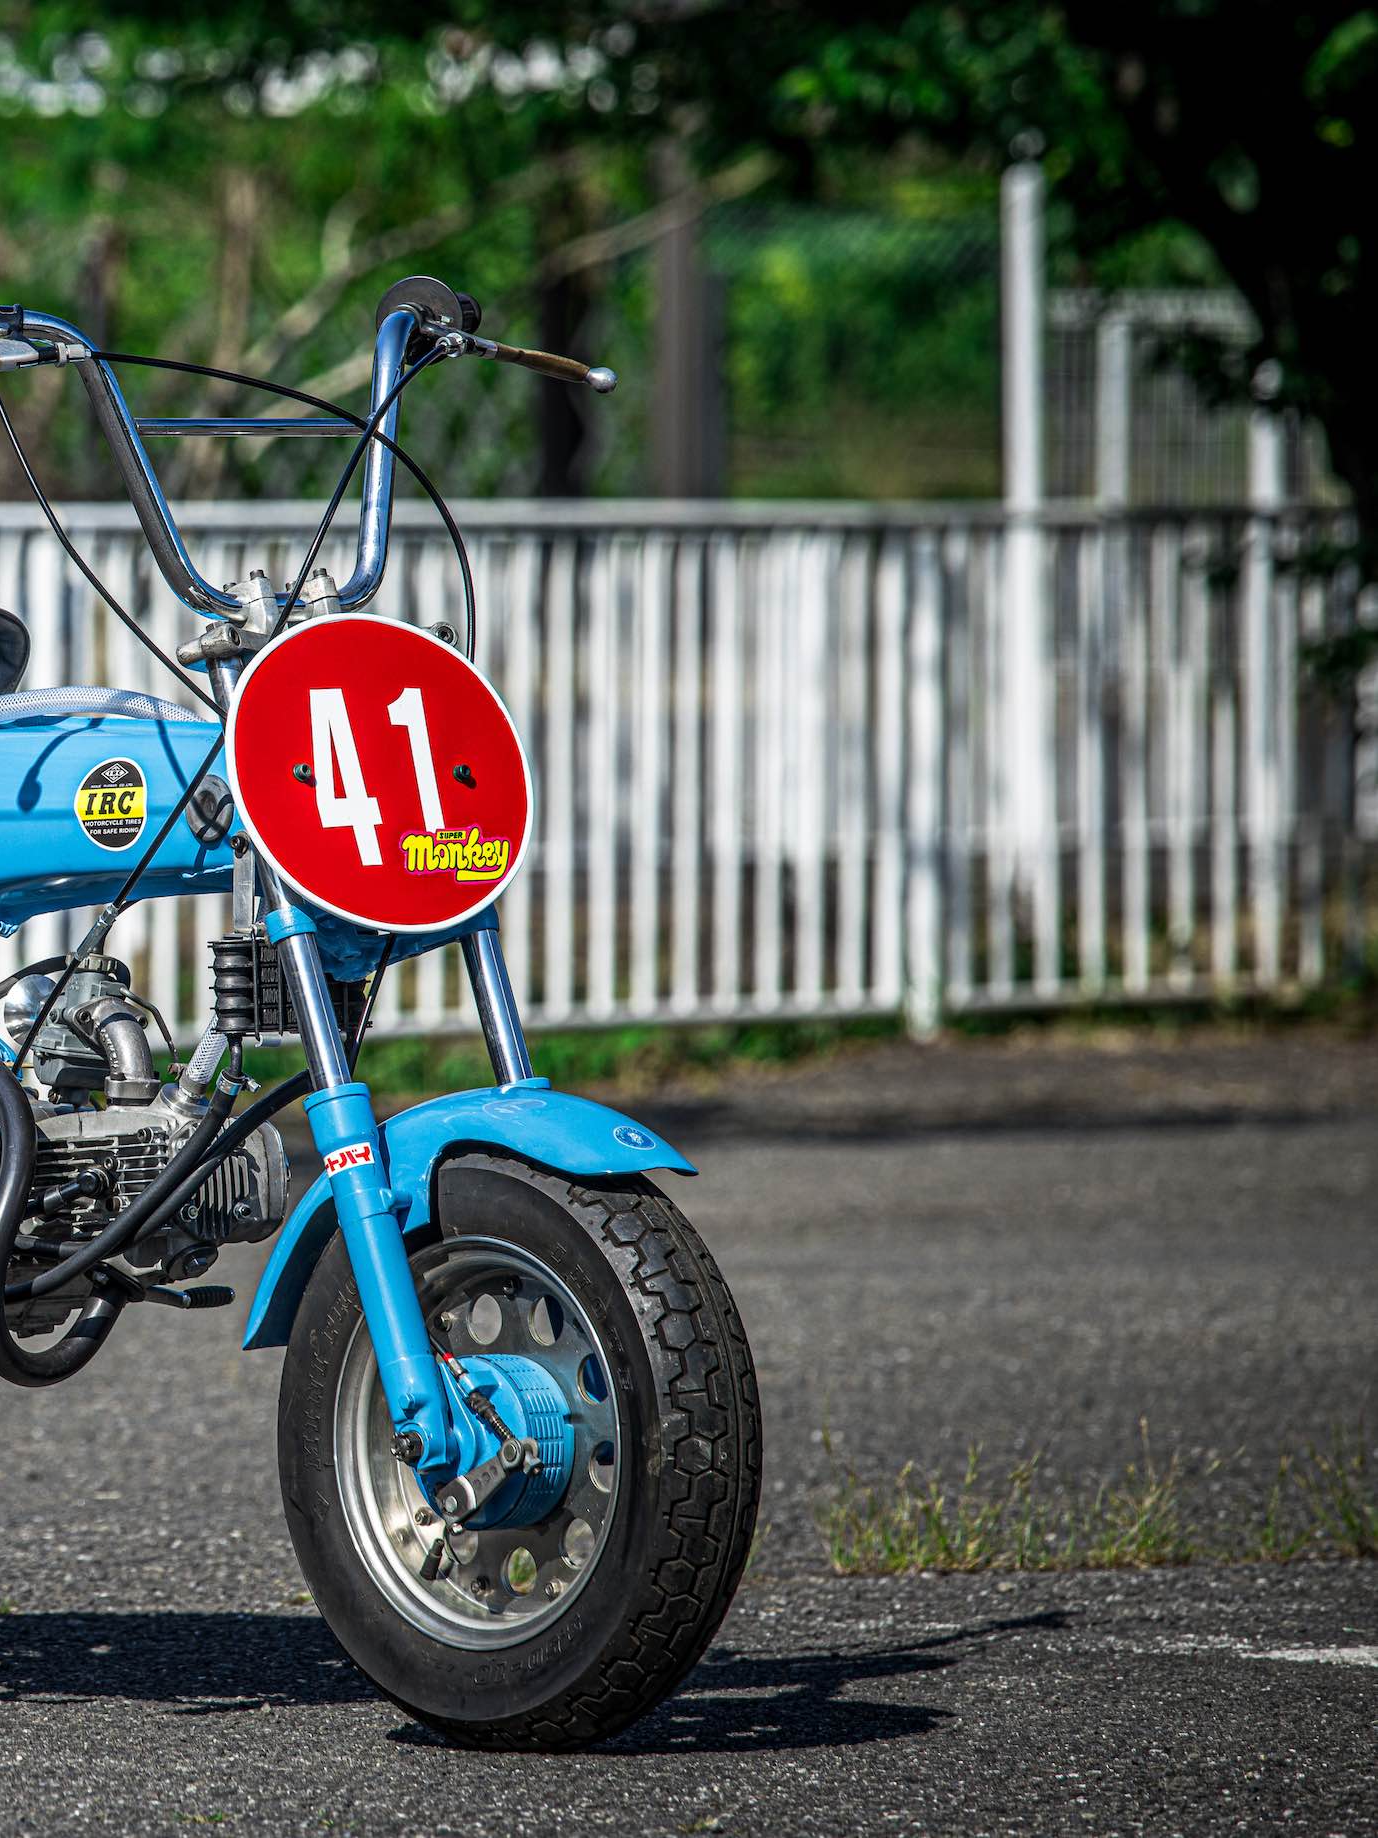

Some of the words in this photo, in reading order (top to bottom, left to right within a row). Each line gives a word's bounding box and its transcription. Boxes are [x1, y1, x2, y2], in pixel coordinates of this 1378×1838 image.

[309, 687, 445, 866] 41
[85, 791, 136, 815] IRC
[439, 832, 463, 840] SUPER
